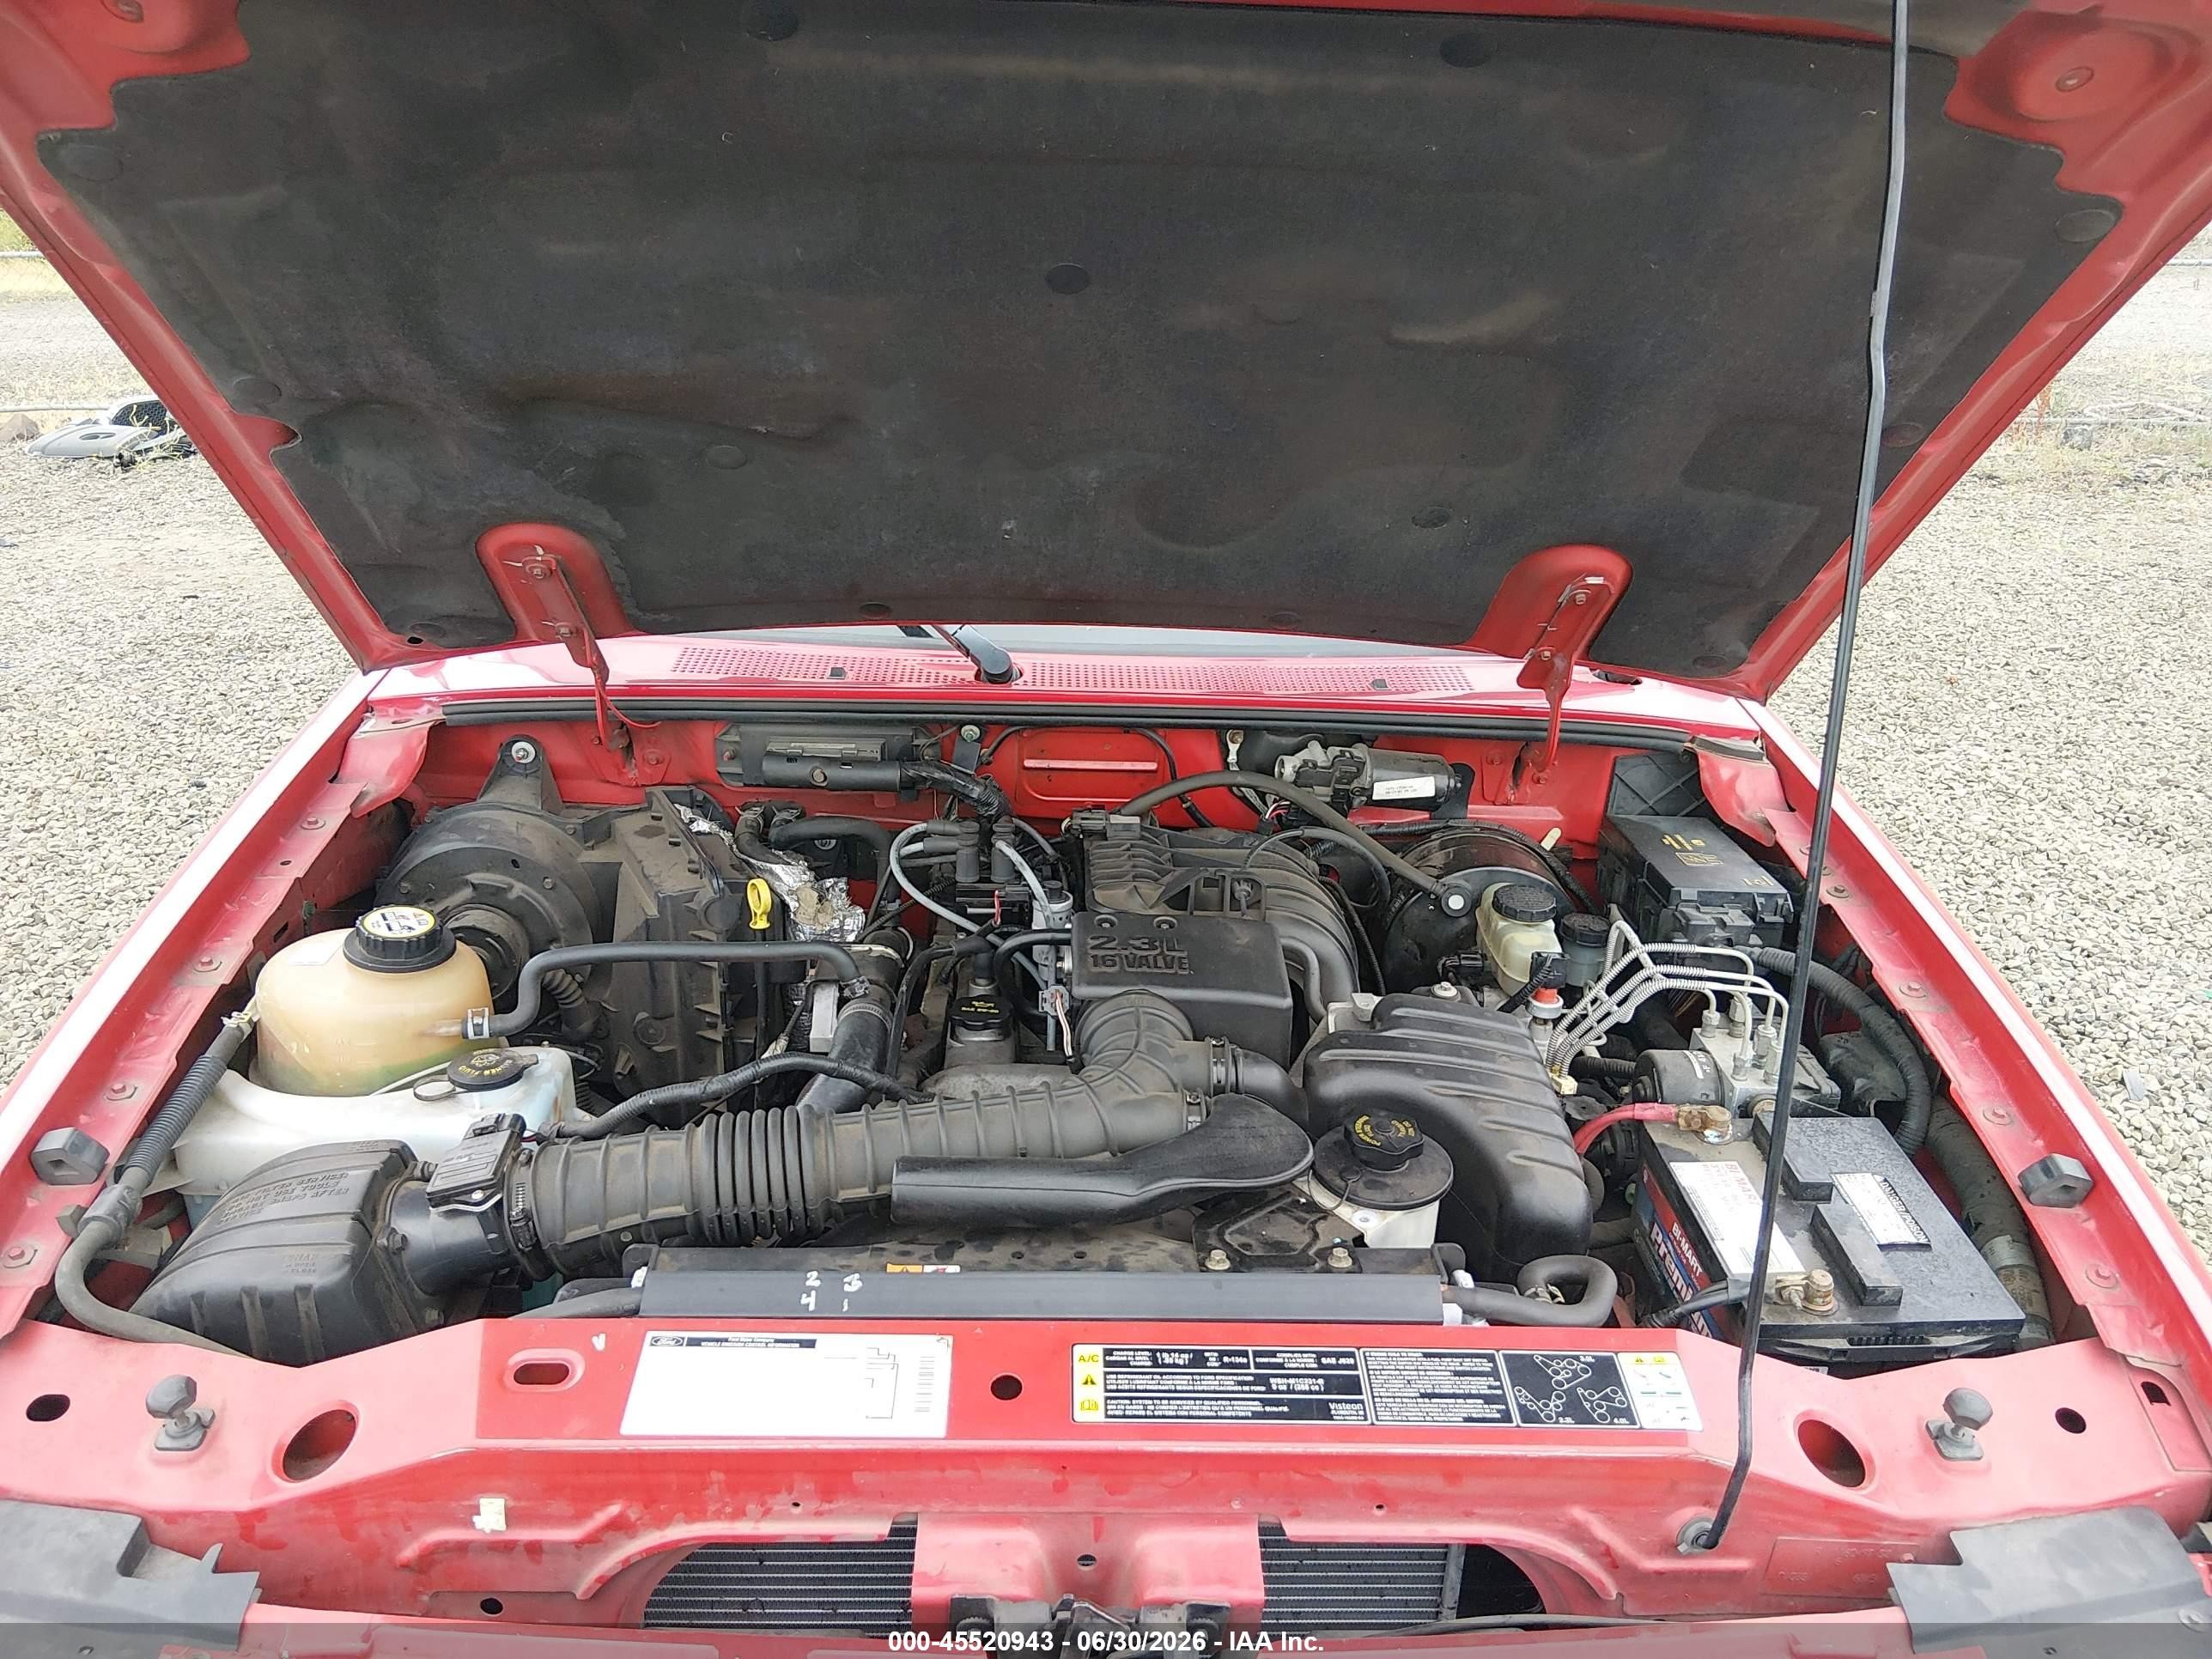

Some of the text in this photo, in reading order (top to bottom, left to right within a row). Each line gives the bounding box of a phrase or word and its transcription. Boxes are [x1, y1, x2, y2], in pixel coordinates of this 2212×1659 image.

[1089, 935, 1185, 955] 2.3L
[1091, 954, 1189, 973] 16 VALVE
[275, 1187, 296, 1197] USE
[301, 1181, 341, 1192] TOOLS
[310, 1188, 349, 1198] AFTER
[1881, 1181, 1929, 1243] DANGER/POISON
[805, 1271, 863, 1292] 2 3
[800, 1290, 817, 1312] 4
[1079, 1354, 1099, 1363] A/C
